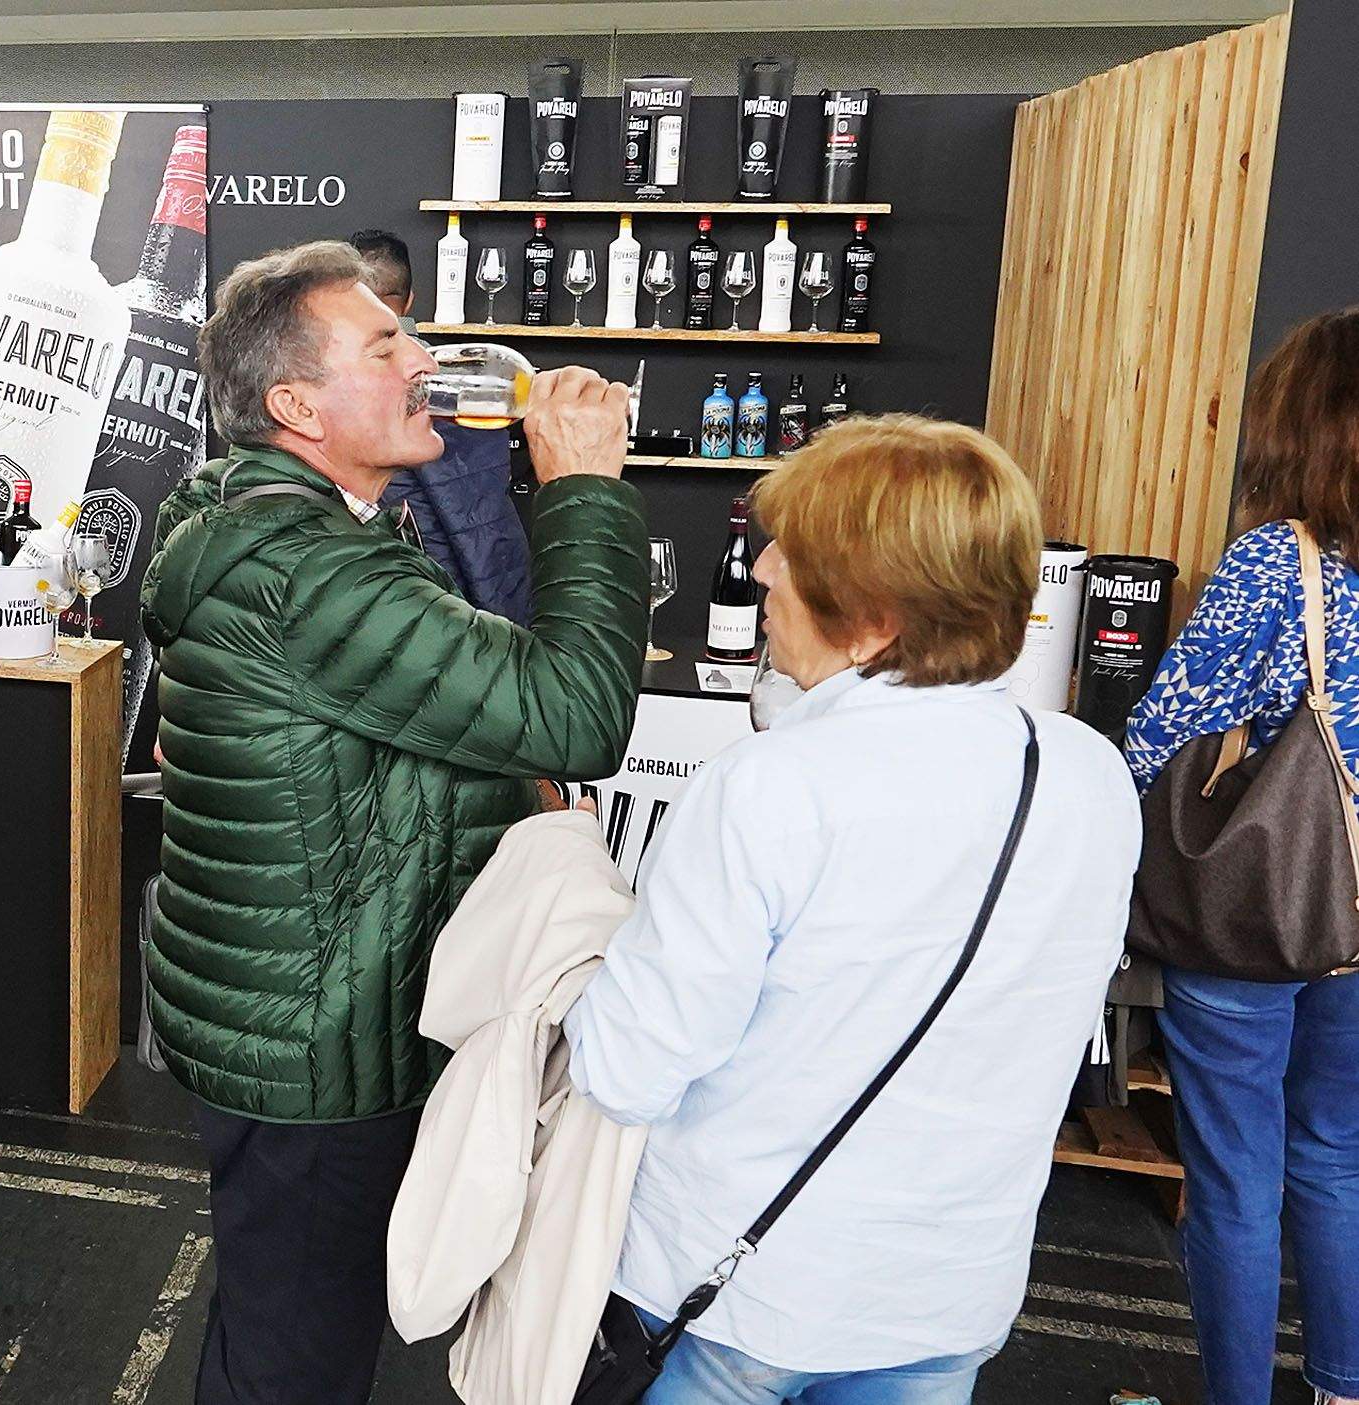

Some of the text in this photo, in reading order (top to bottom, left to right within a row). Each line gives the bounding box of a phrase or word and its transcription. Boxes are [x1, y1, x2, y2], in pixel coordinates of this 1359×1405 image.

[629, 90, 683, 108] POVARELO
[536, 101, 578, 118] POVARELO
[744, 100, 787, 117] POVARELO
[824, 100, 868, 116] POVARELO
[114, 355, 206, 434] AREL
[1089, 574, 1161, 603] POVARELO
[8, 599, 38, 609] VERMUT
